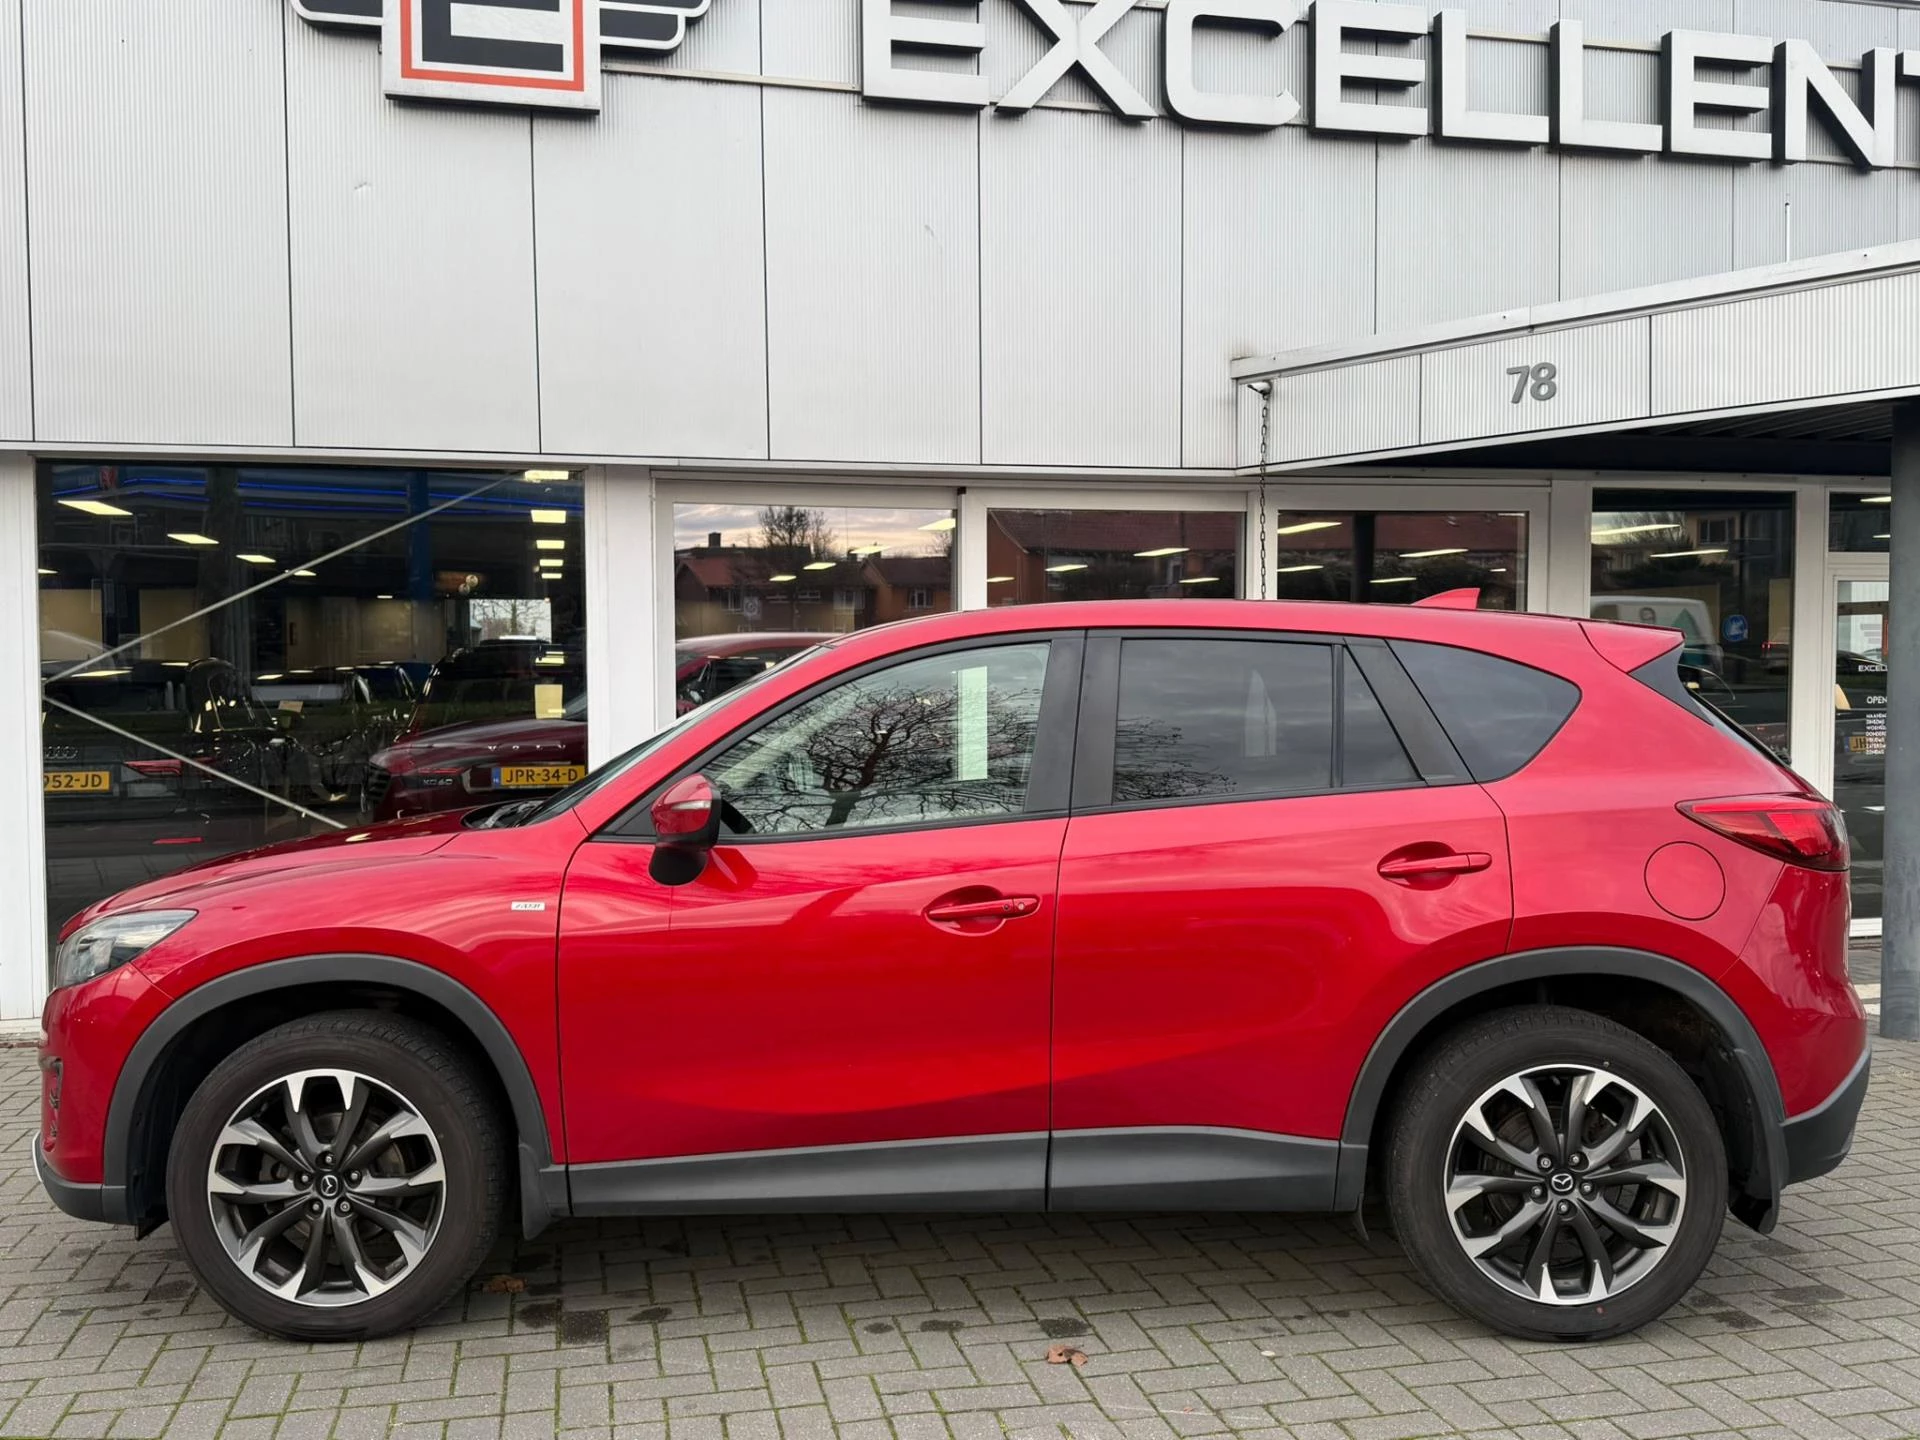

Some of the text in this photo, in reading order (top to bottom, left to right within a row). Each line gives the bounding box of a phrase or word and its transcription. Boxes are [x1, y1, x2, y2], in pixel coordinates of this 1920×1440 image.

[862, 0, 1920, 168] EXCELLEN
[1506, 362, 1557, 404] 78
[505, 768, 578, 783] JPR-34-D
